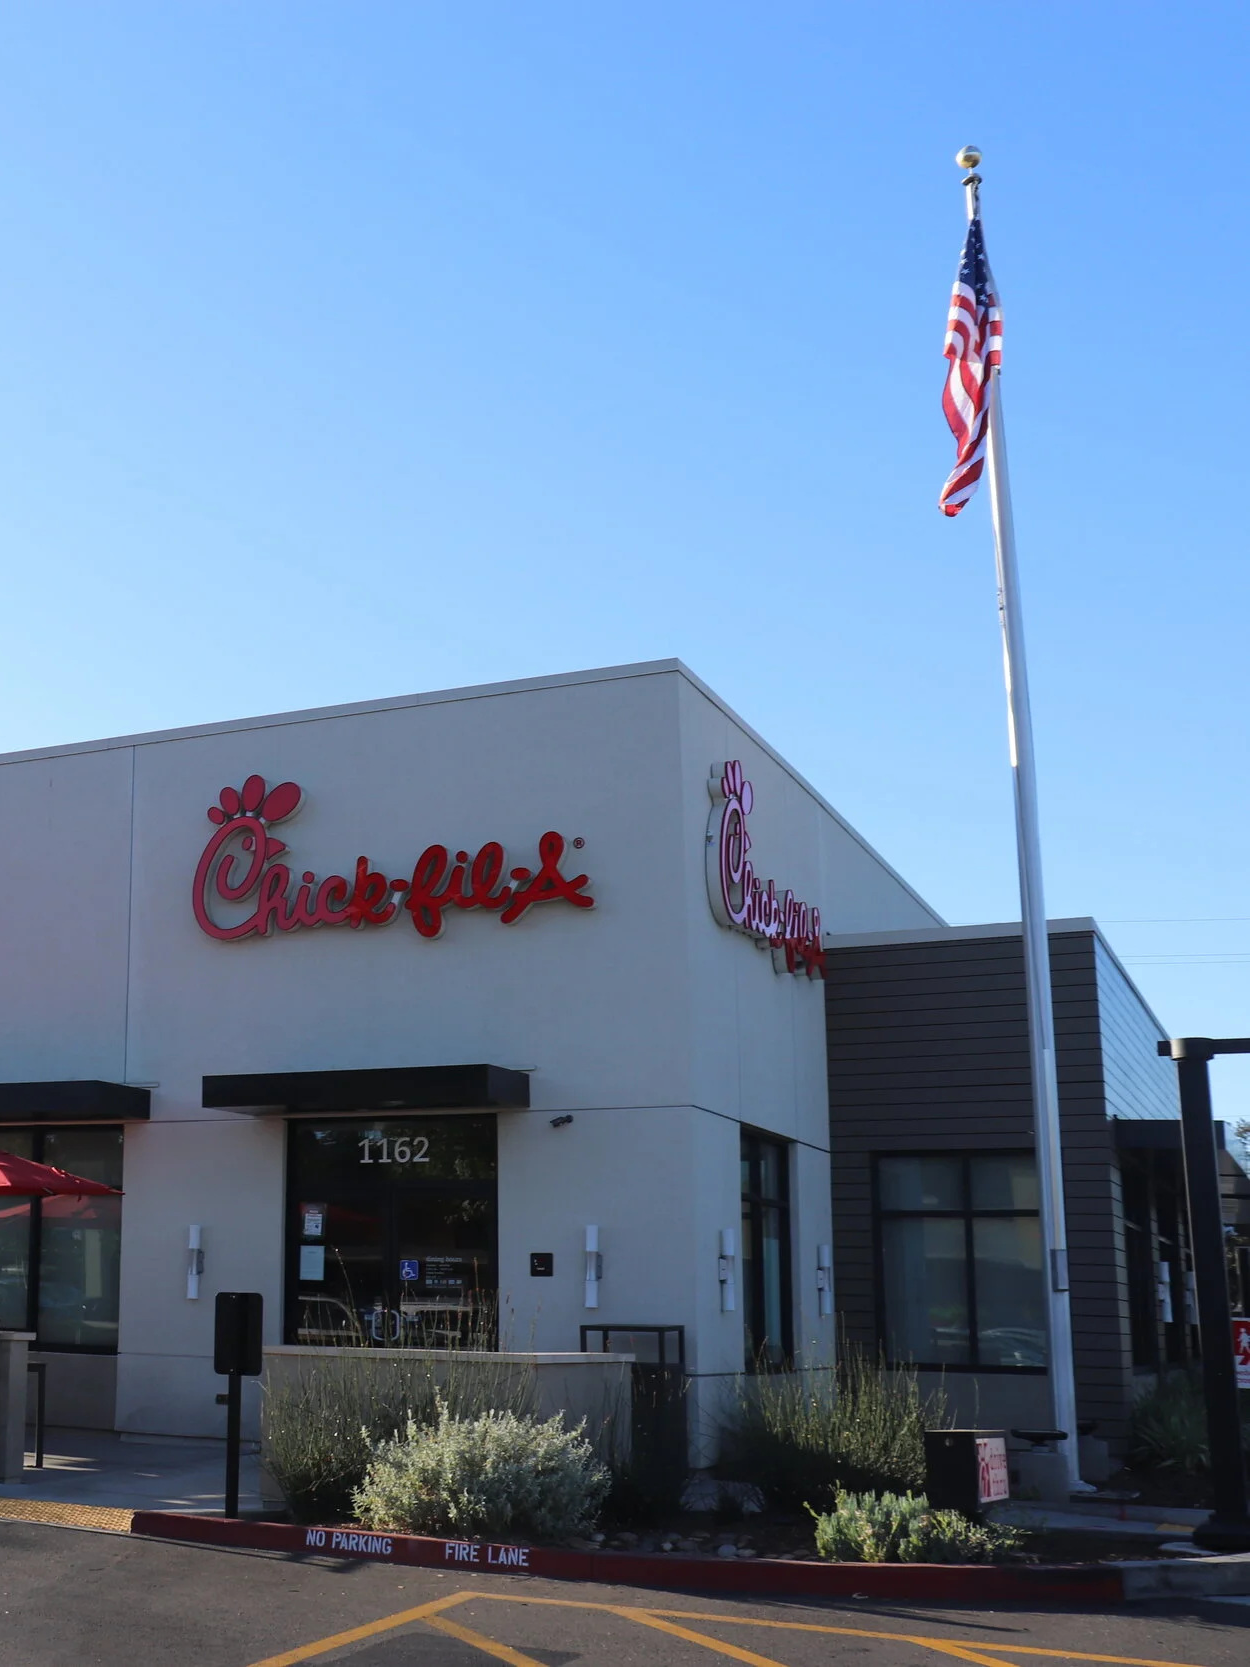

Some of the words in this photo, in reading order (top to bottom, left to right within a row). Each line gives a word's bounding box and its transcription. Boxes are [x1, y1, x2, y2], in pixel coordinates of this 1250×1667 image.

[358, 1136, 430, 1164] 1162
[305, 1529, 326, 1547] NO
[332, 1532, 393, 1555] PARKING
[445, 1542, 481, 1562] FIRE
[488, 1546, 530, 1567] LANE
